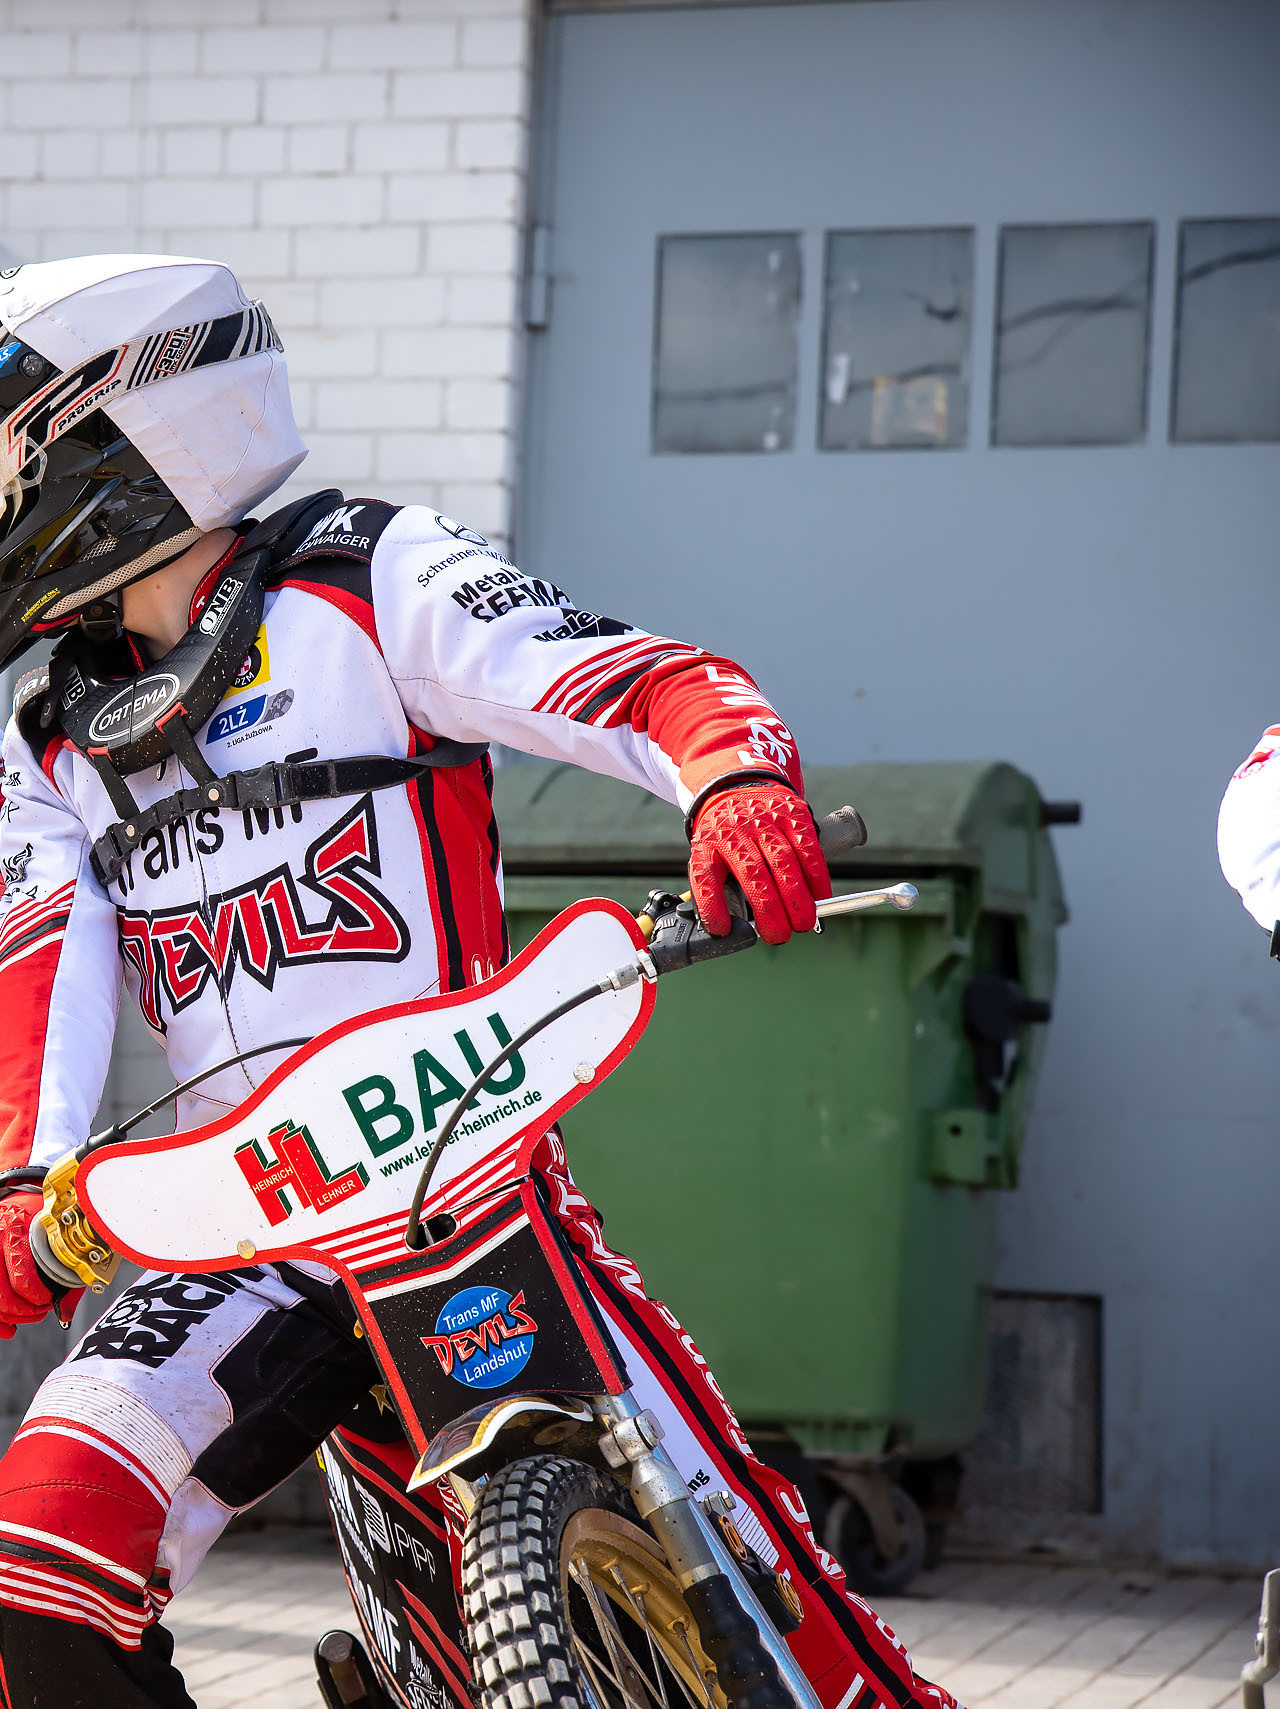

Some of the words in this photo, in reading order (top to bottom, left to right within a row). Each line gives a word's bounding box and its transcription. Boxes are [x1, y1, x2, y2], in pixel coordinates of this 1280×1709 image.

[234, 671, 255, 686] PZM
[98, 684, 167, 731] ORTEMA
[219, 705, 249, 735] 2LŻ
[117, 792, 411, 1036] DEVILS
[342, 1013, 527, 1158] BAU
[379, 1089, 543, 1178] www.leher-heinrich.de
[251, 1166, 294, 1194] HEINRICH
[316, 1180, 356, 1206] LEHNER
[420, 1289, 539, 1376] DEVILS
[443, 1305, 479, 1331] Trans
[480, 1291, 500, 1313] MF
[463, 1340, 528, 1383] Landshut
